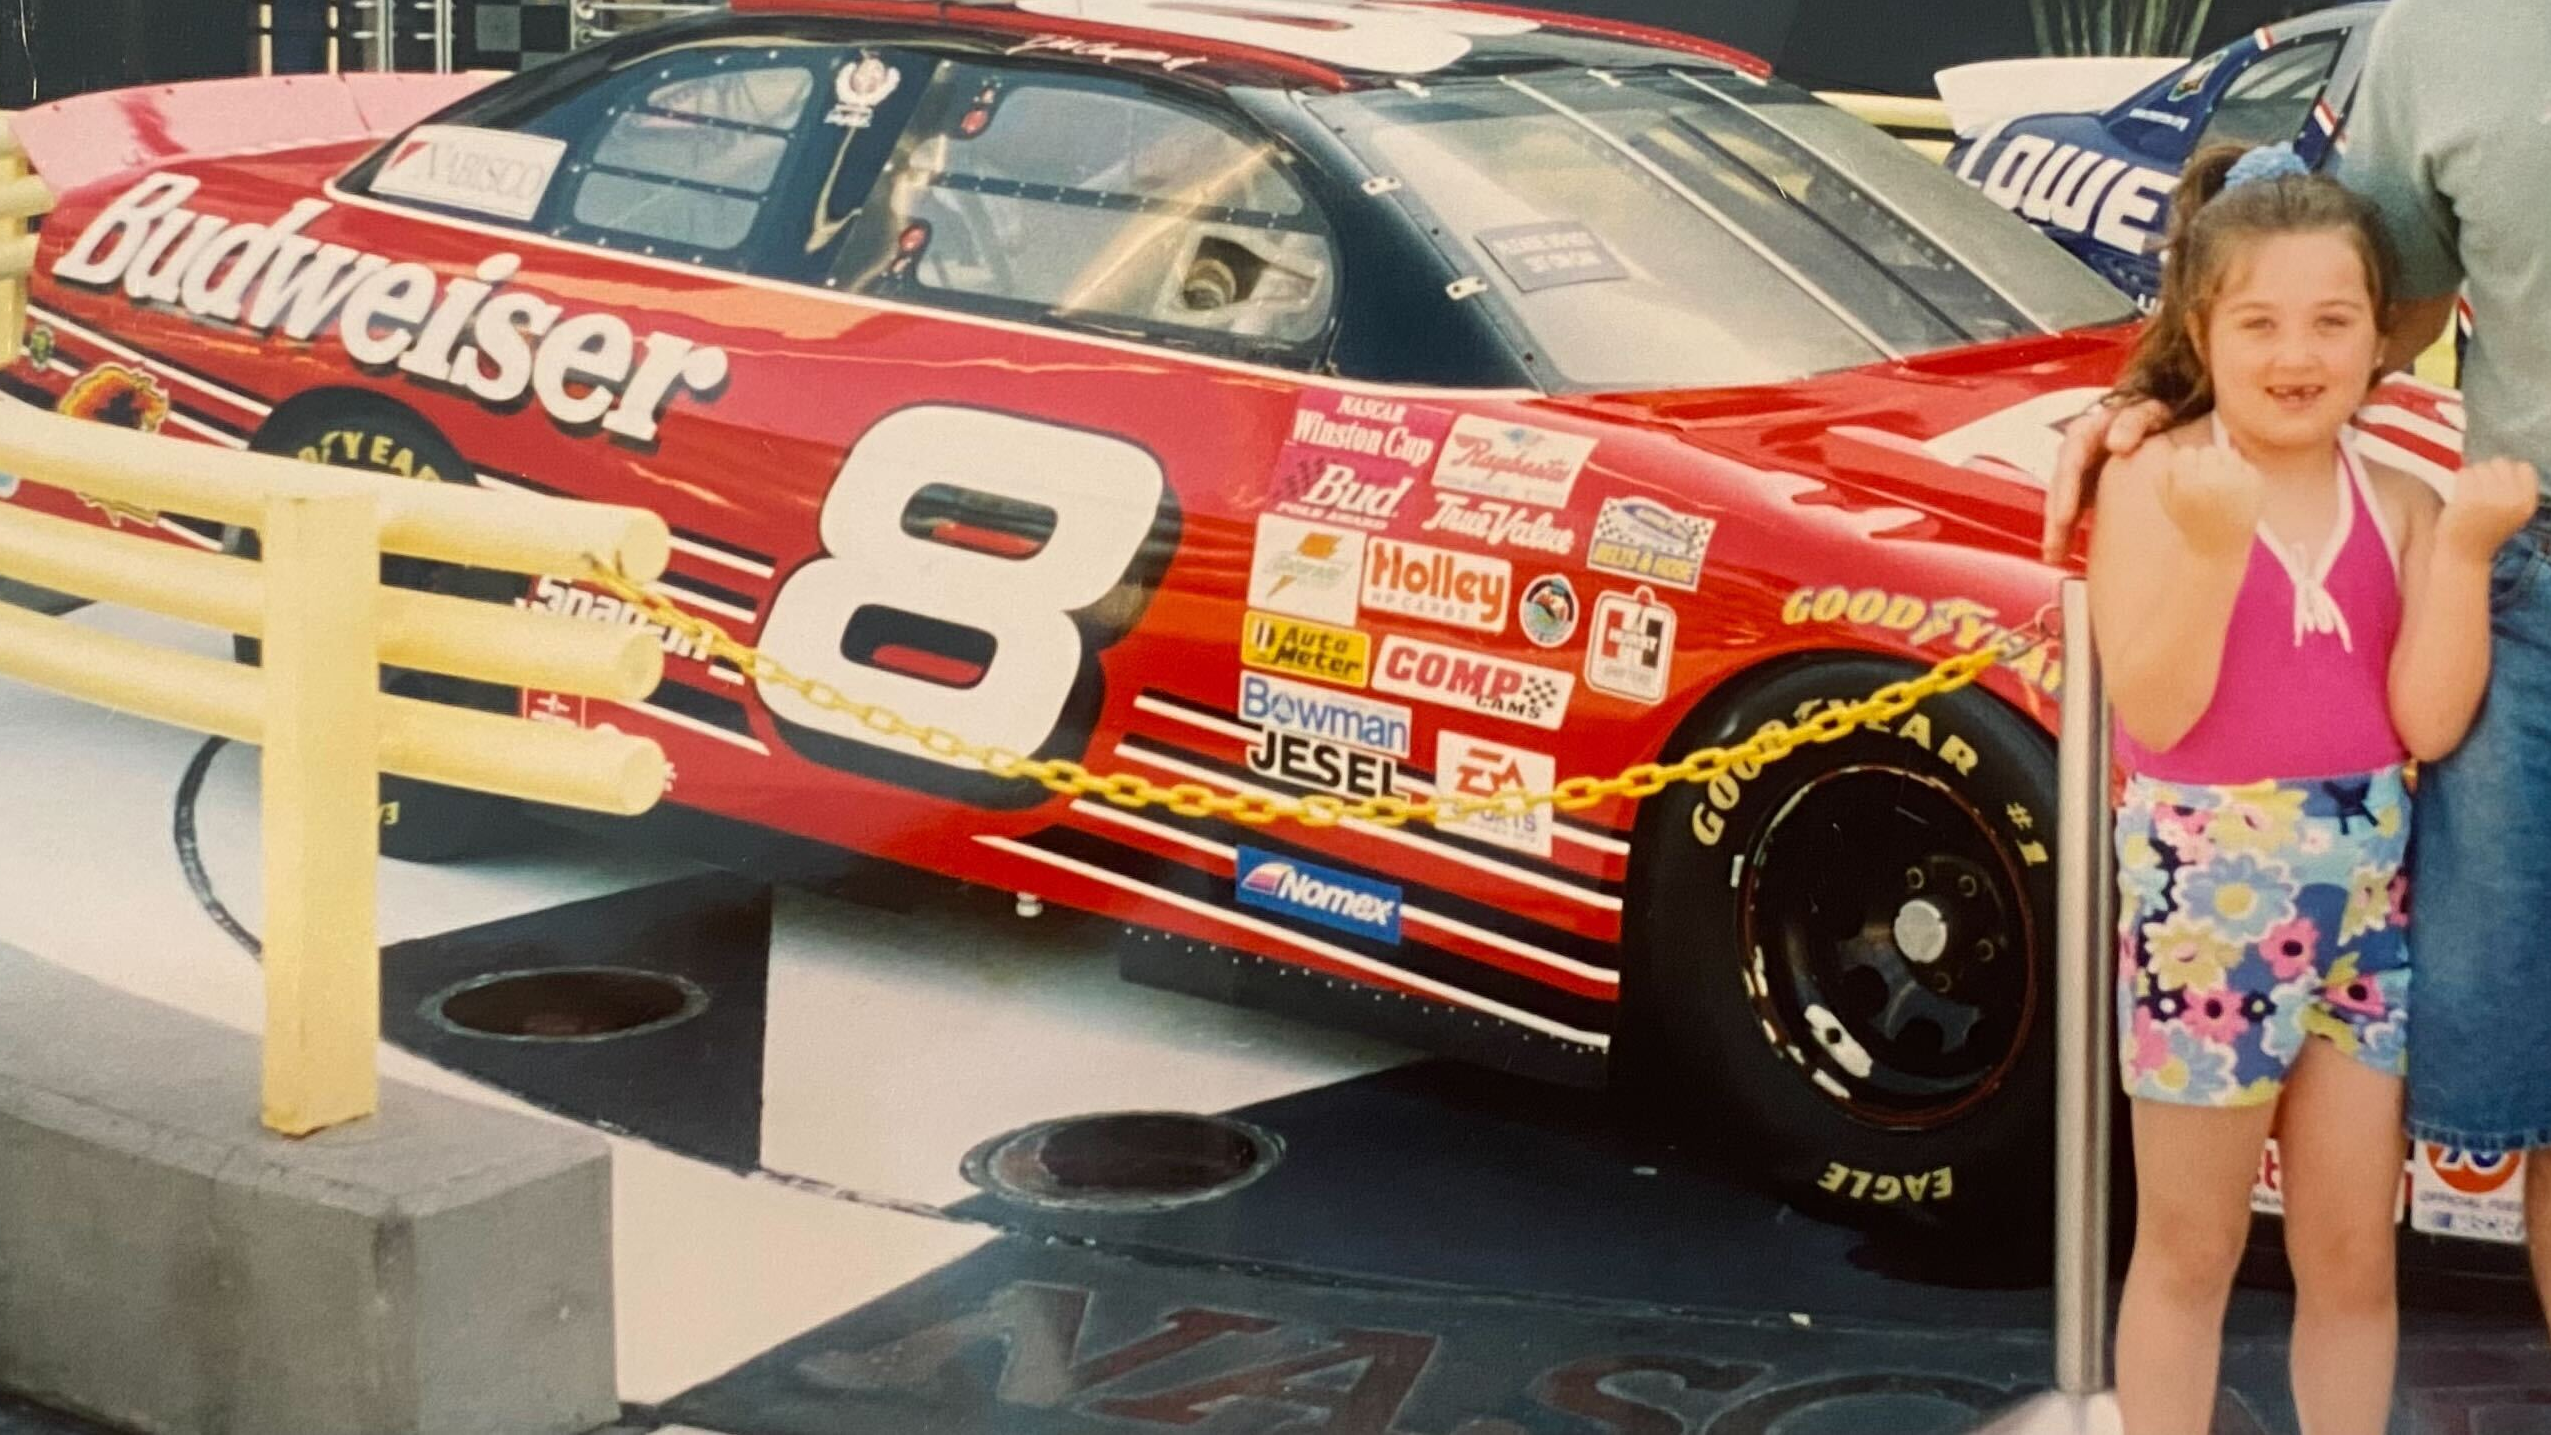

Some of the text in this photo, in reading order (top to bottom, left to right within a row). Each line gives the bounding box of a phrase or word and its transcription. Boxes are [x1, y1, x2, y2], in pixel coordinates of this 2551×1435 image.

[1956, 118, 2182, 254] LOWE
[53, 174, 728, 442] Budweiser
[1336, 394, 1407, 423] NASCAR
[1292, 408, 1434, 467] Winston Cup
[1300, 463, 1414, 518] Bud
[755, 403, 1166, 772] 8
[1371, 542, 1505, 624] Holley
[1273, 645, 1362, 676] Meter
[1281, 626, 1349, 654] Auto
[1385, 646, 1523, 702] COMP
[1244, 676, 1408, 751] Bowman
[1475, 694, 1542, 719] CAMS
[1456, 748, 1525, 798] EA
[2005, 802, 2049, 866] #1
[1277, 868, 1396, 926] Nomex
[1817, 1162, 1953, 1202] EAGLE
